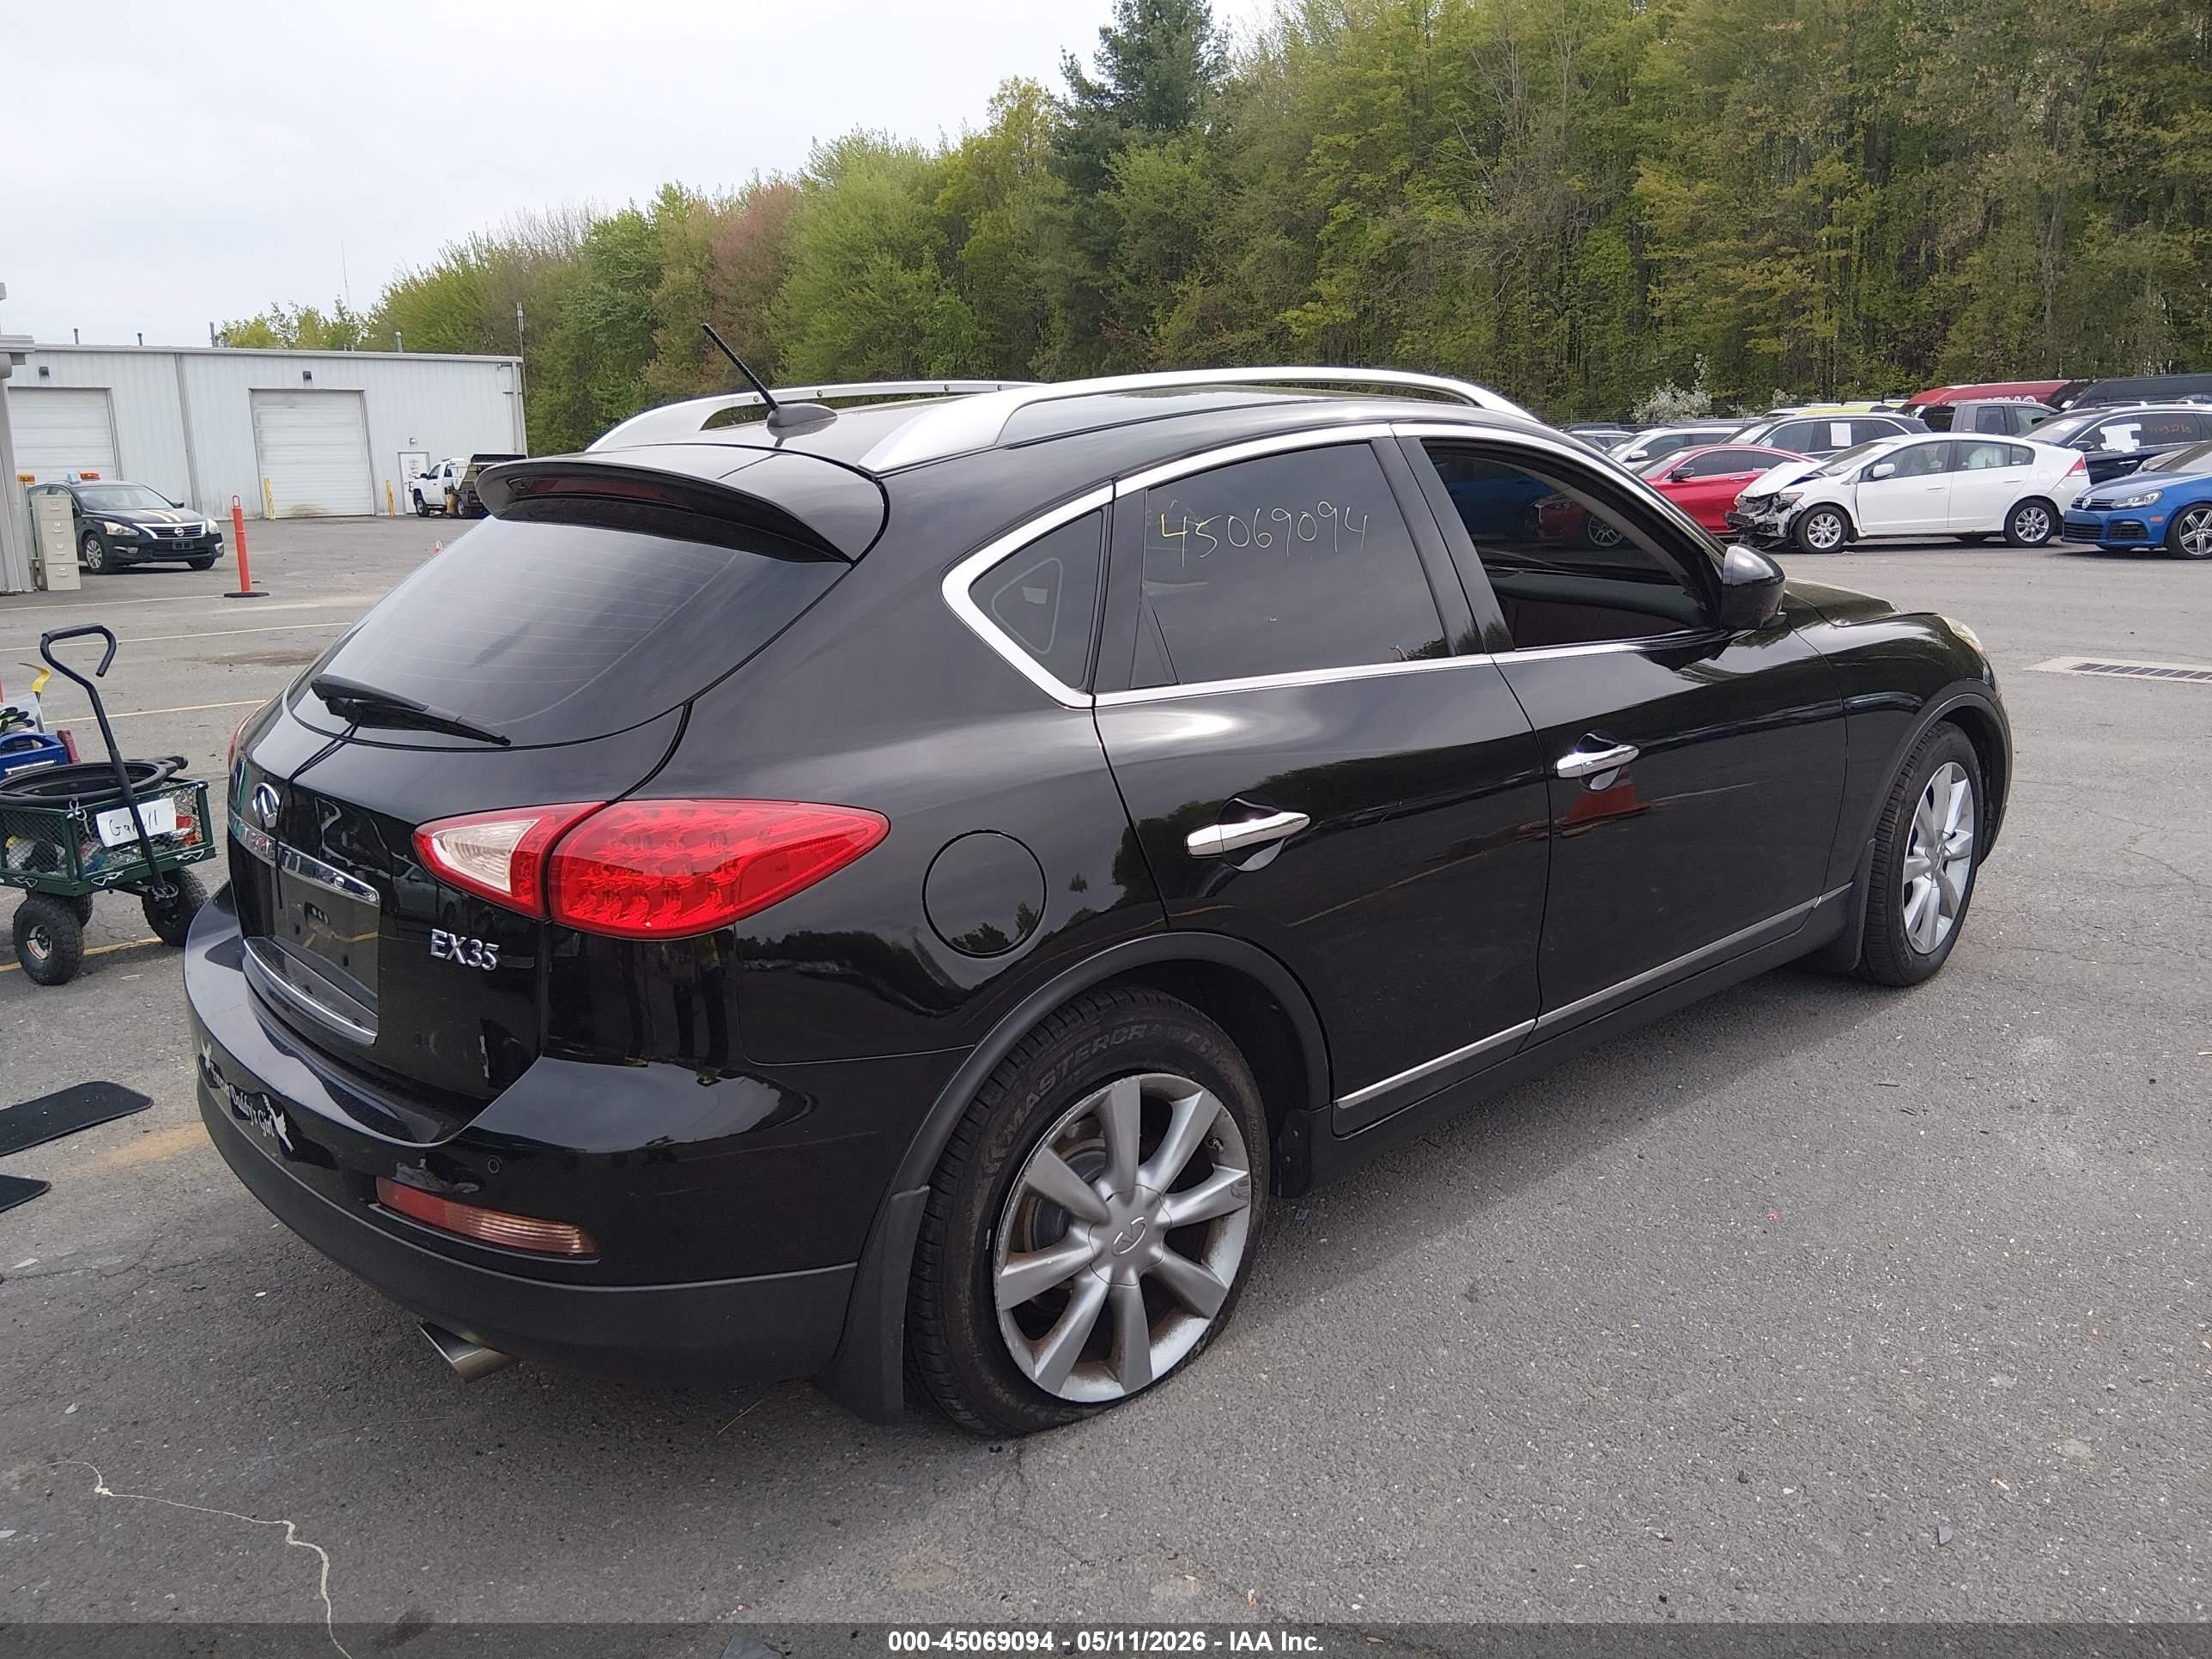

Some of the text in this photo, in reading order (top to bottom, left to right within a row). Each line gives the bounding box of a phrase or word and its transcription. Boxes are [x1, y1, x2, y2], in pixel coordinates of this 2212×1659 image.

[1160, 501, 1368, 568] 45069094
[430, 928, 500, 970] EX35
[258, 1108, 276, 1138] Girl
